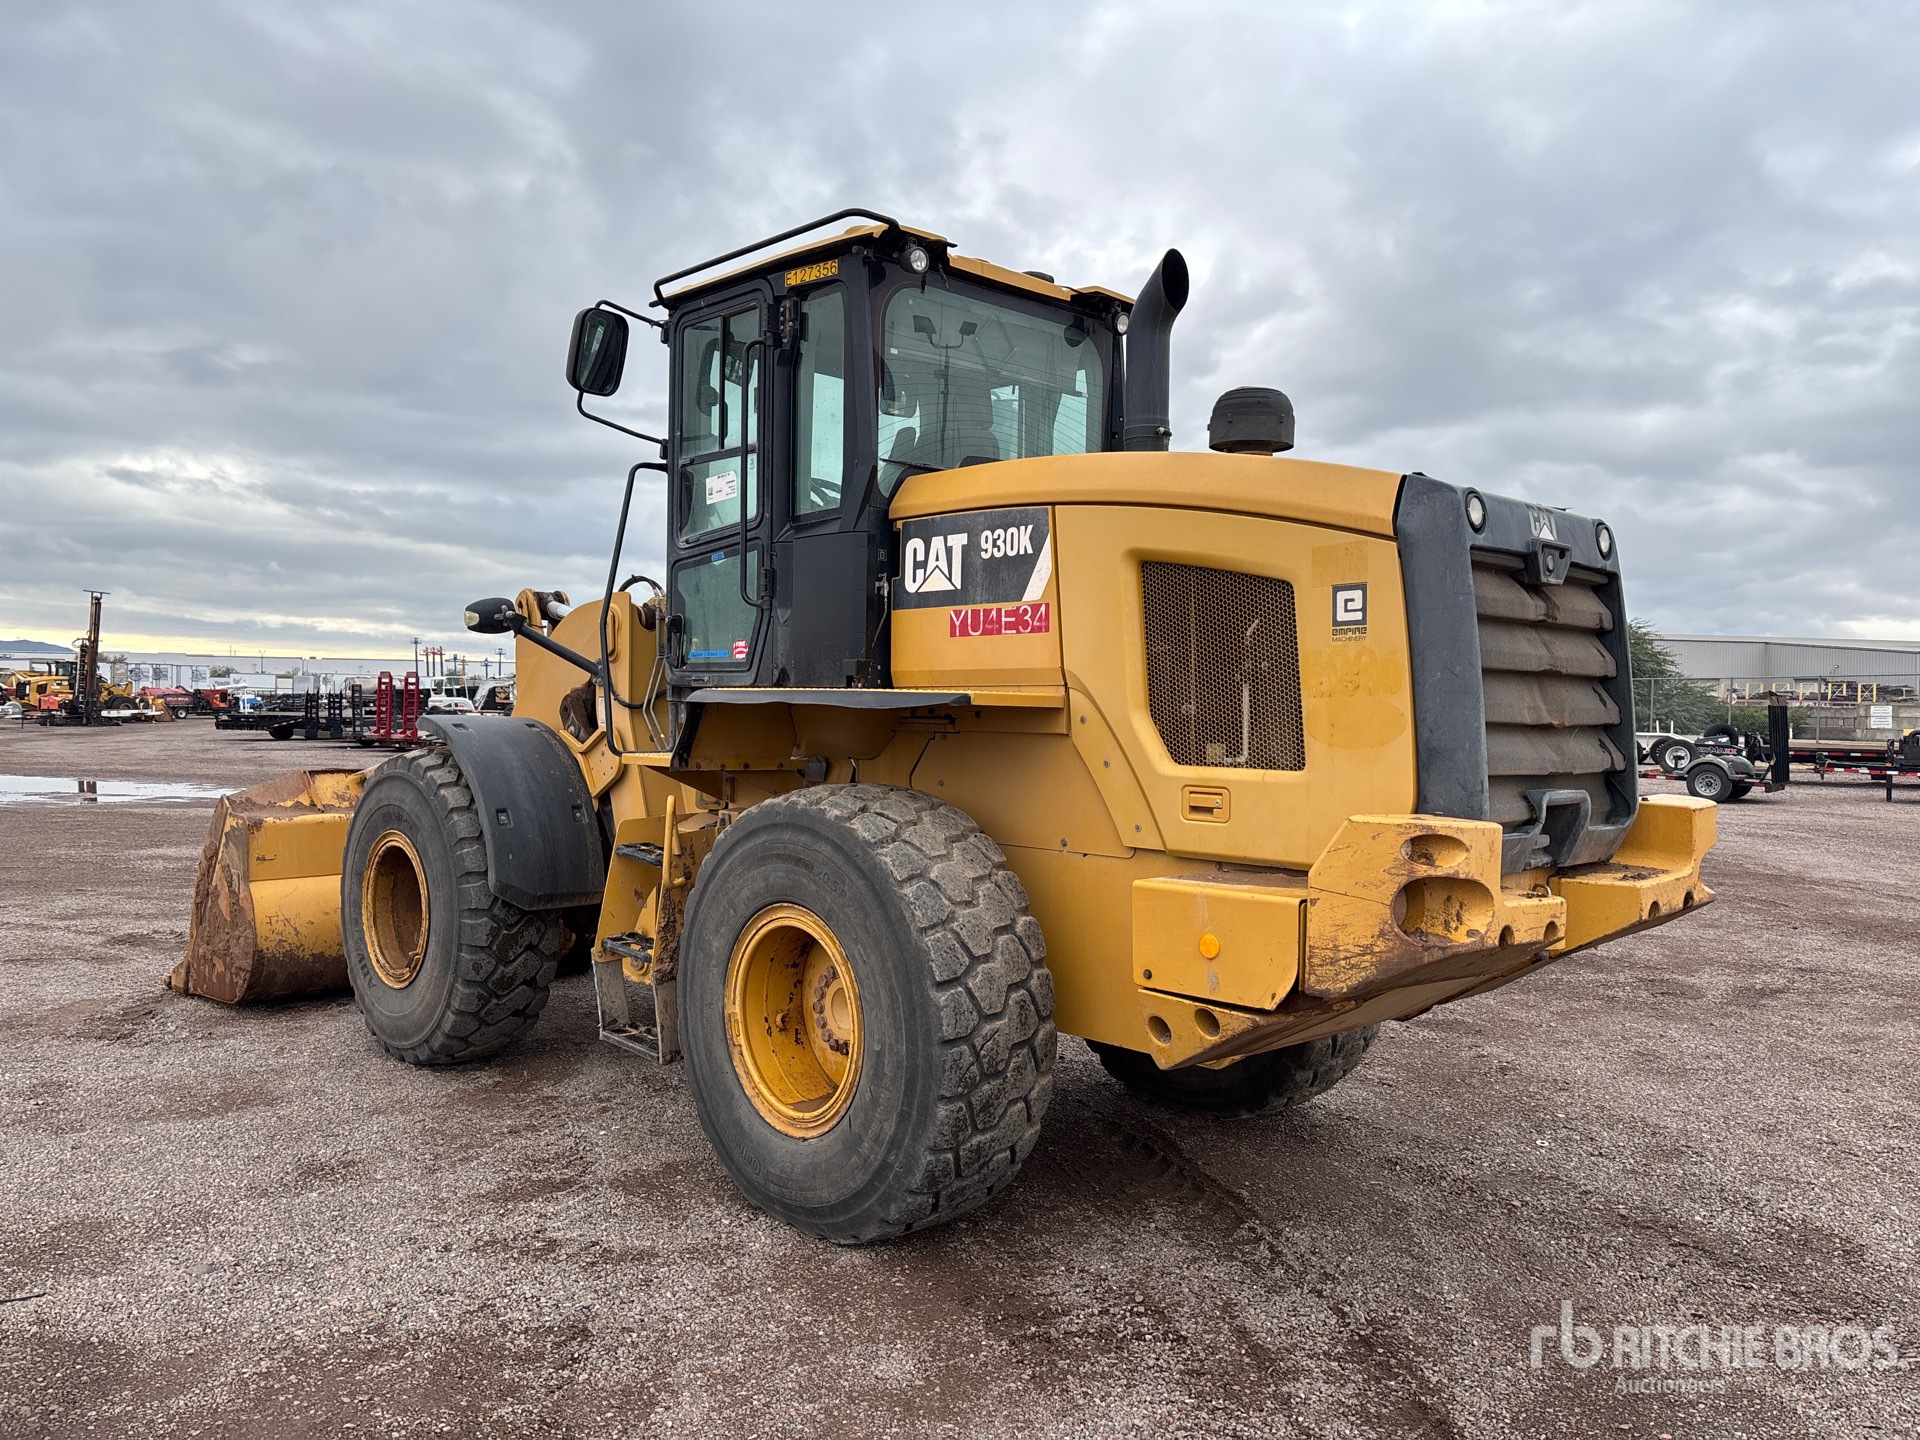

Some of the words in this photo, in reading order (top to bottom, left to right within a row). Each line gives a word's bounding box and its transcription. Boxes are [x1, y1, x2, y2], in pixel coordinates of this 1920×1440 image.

[785, 260, 837, 285] E127356
[1524, 503, 1558, 541] CAT
[904, 533, 968, 593] CAT
[980, 524, 1034, 559] 930K
[950, 604, 1048, 637] YU4E34
[1331, 635, 1368, 643] MACHINERY
